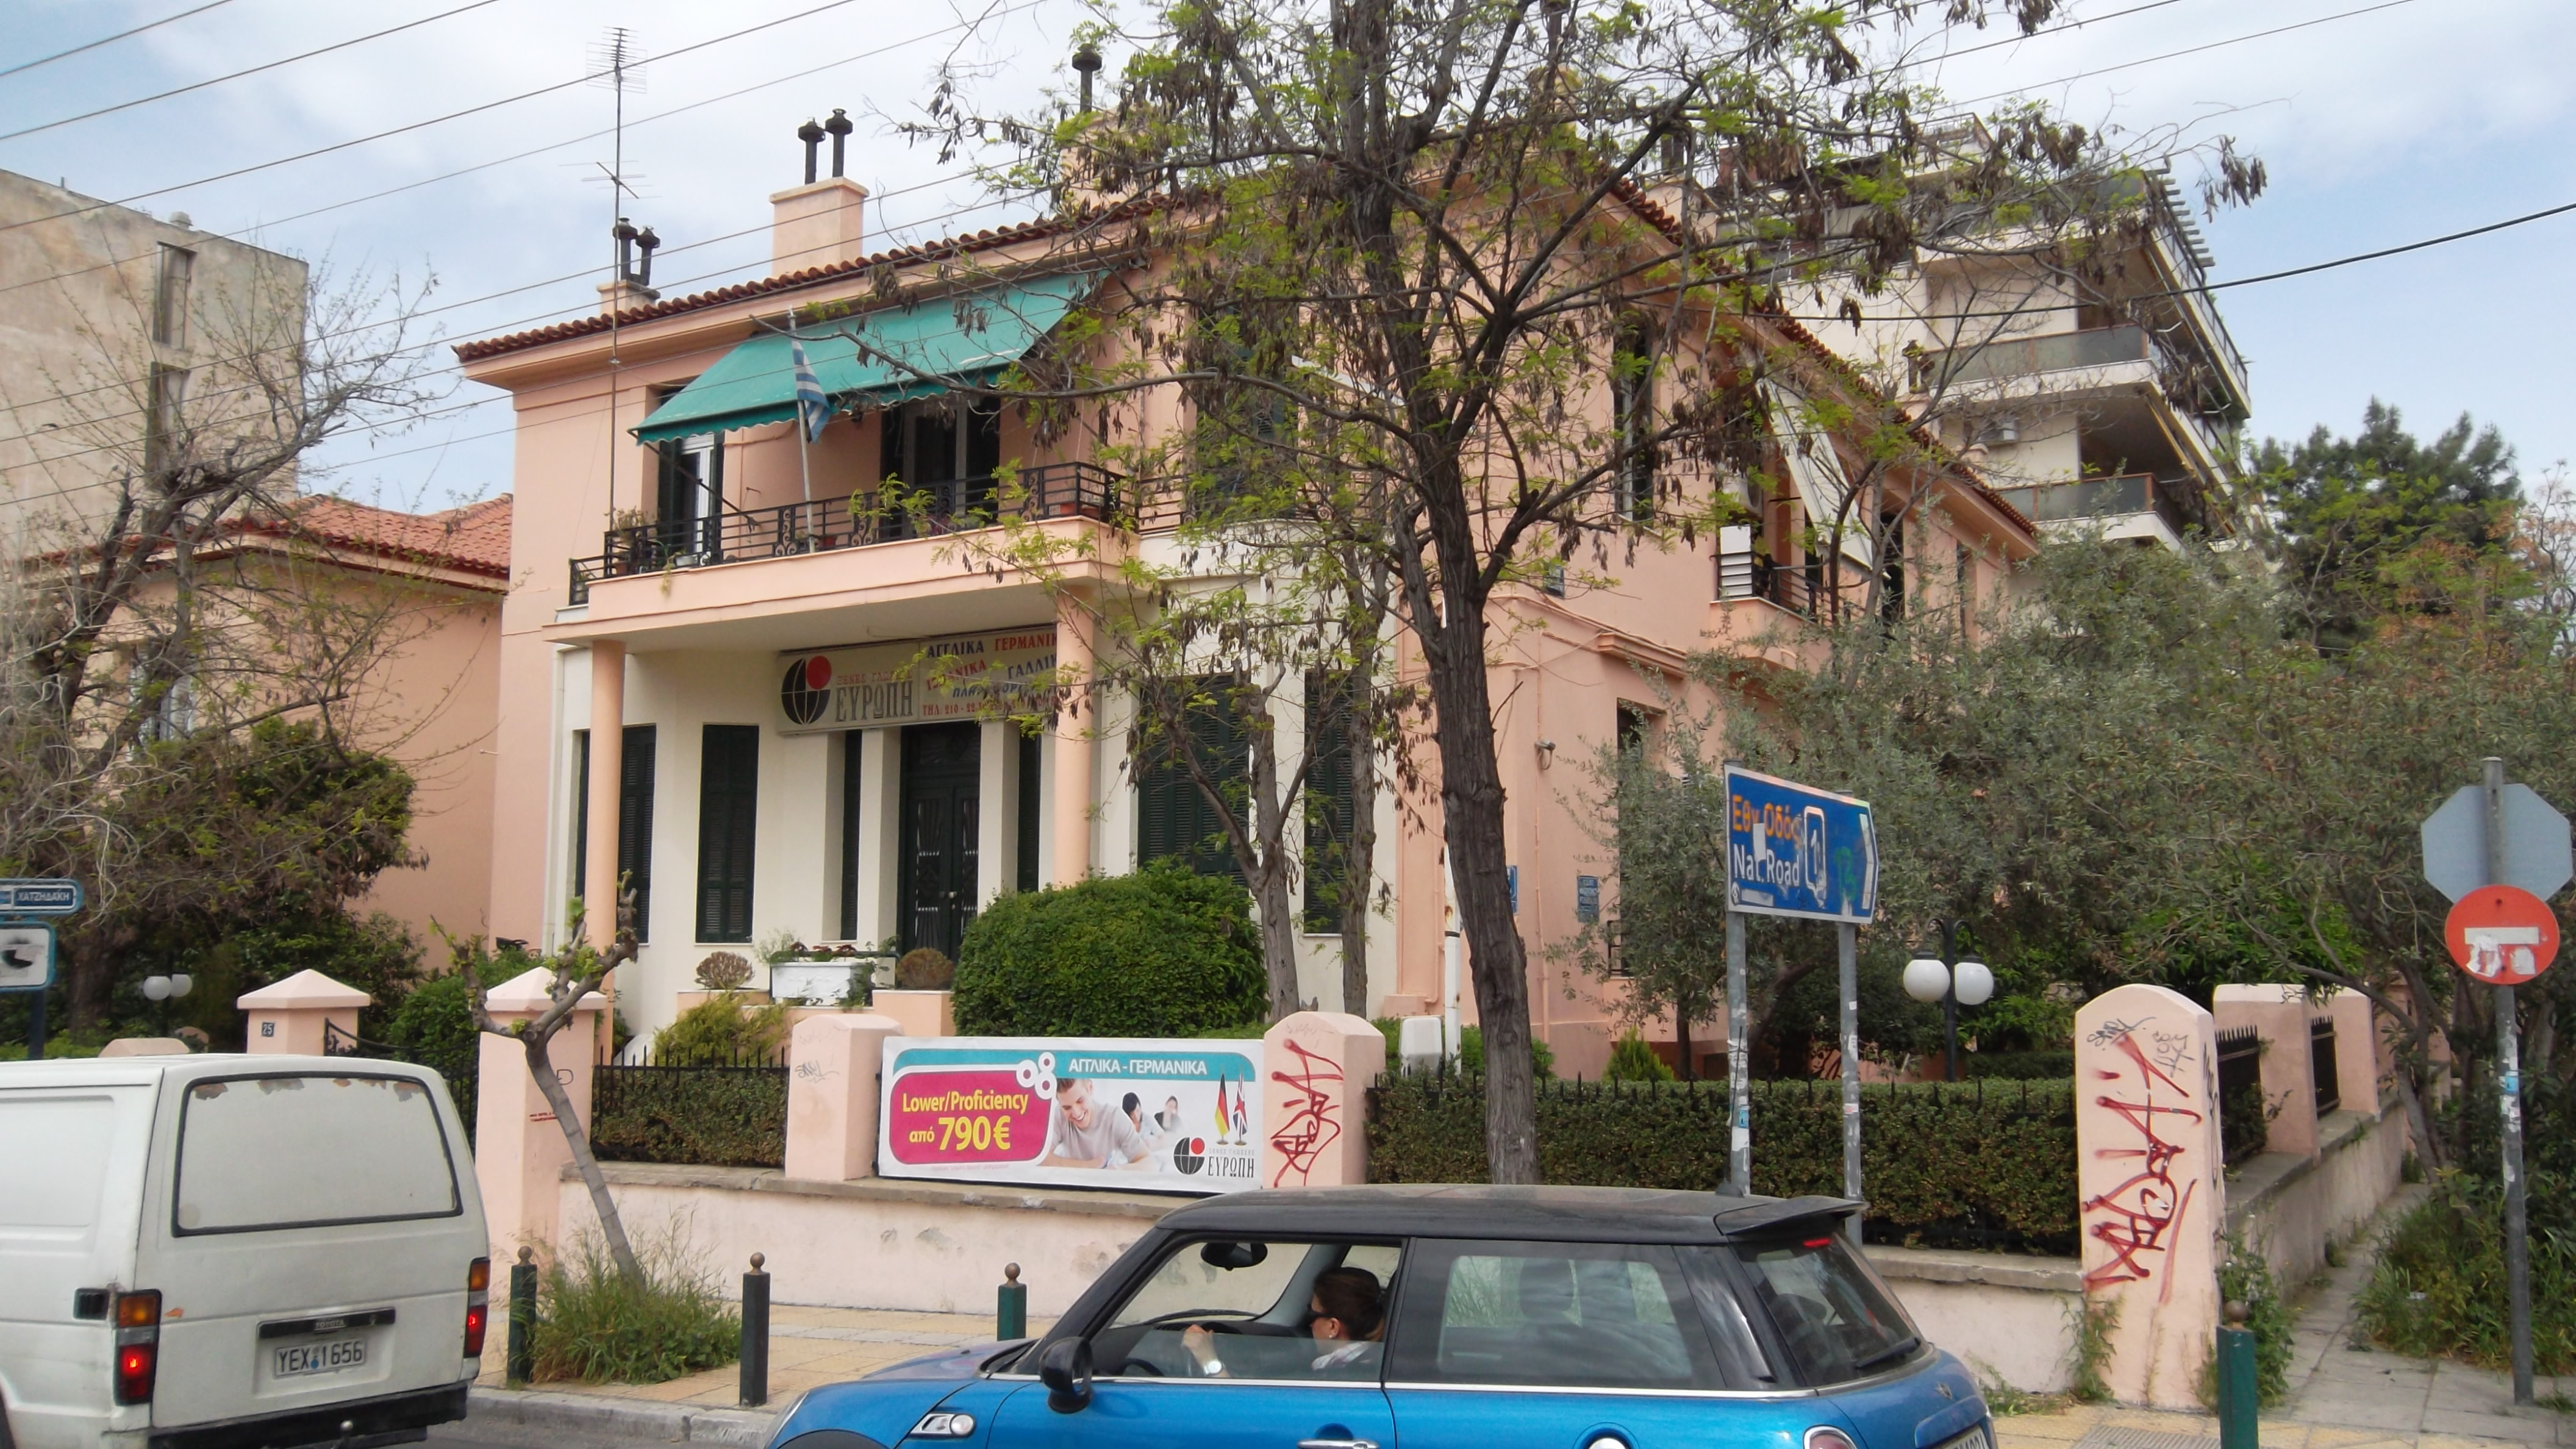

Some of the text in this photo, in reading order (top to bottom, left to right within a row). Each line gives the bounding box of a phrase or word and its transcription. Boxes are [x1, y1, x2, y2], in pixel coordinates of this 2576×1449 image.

[927, 633, 1057, 658] ΑΓΓΛΙΚΑ ΓΕΡΜΑΝΙΚ
[926, 659, 986, 690] ΙΣΑΝΙΚΑ
[1007, 653, 1057, 679] ΓΑΛΛΙΚ
[835, 681, 913, 722] ΕΥΡΩΠΗ
[945, 704, 959, 714] 210
[1766, 848, 1800, 887] Road
[263, 1023, 273, 1035] 25
[1069, 1058, 1121, 1073] ΑΓΓΛΙΚΑ
[1129, 1060, 1208, 1075] ΓΕΡΜΑΝΙΚΑ
[902, 1089, 1029, 1115] Lower/Proficiency
[909, 1126, 935, 1143] από
[1208, 1156, 1254, 1178] ΕΥΡΩΠΗ
[315, 1319, 345, 1329] TOYOTA
[279, 1342, 363, 1372] YEX 1656
